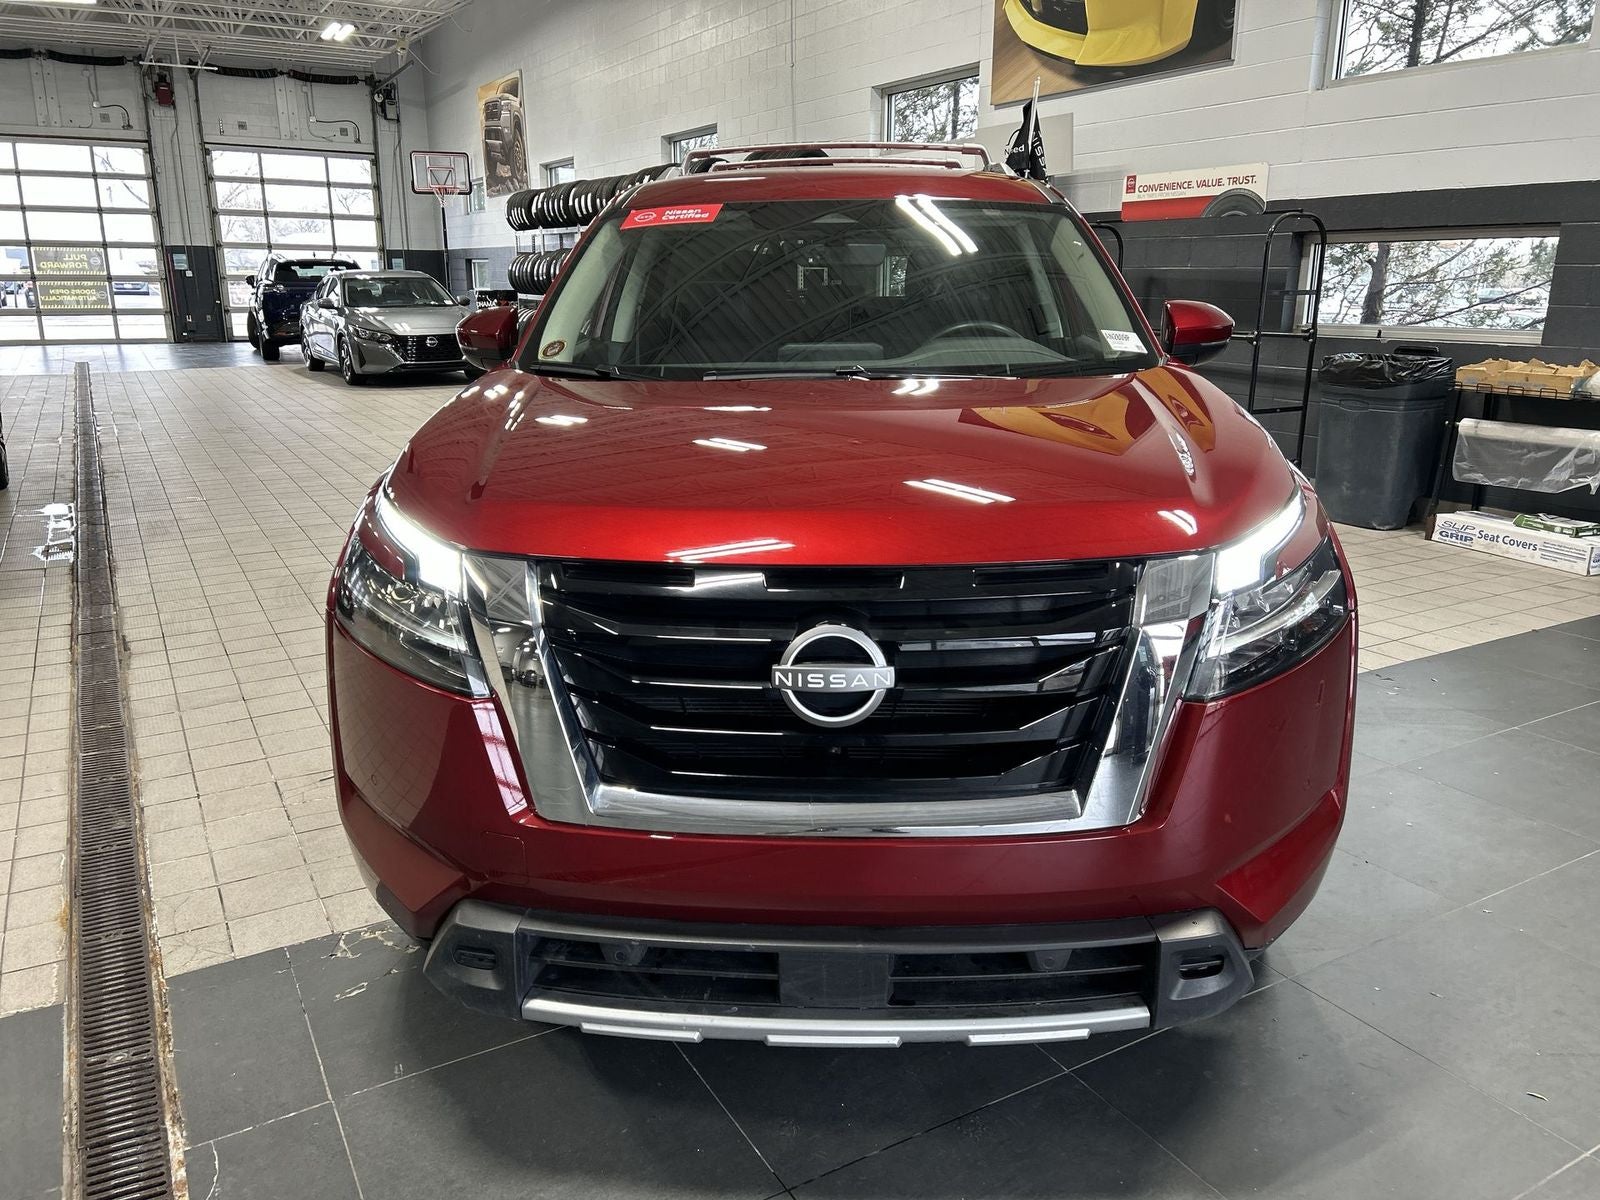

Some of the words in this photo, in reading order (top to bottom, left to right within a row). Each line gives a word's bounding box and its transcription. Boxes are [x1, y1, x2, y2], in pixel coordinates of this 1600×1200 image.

[1137, 180, 1195, 193] CONVENIENCE.
[1196, 177, 1225, 188] VALUE.
[1227, 174, 1257, 186] TRUST.
[1441, 520, 1476, 532] SLIP
[1440, 530, 1474, 542] GRIP
[1478, 530, 1500, 543] Seat
[1502, 536, 1538, 551] Covers
[775, 671, 890, 688] NISSAN
